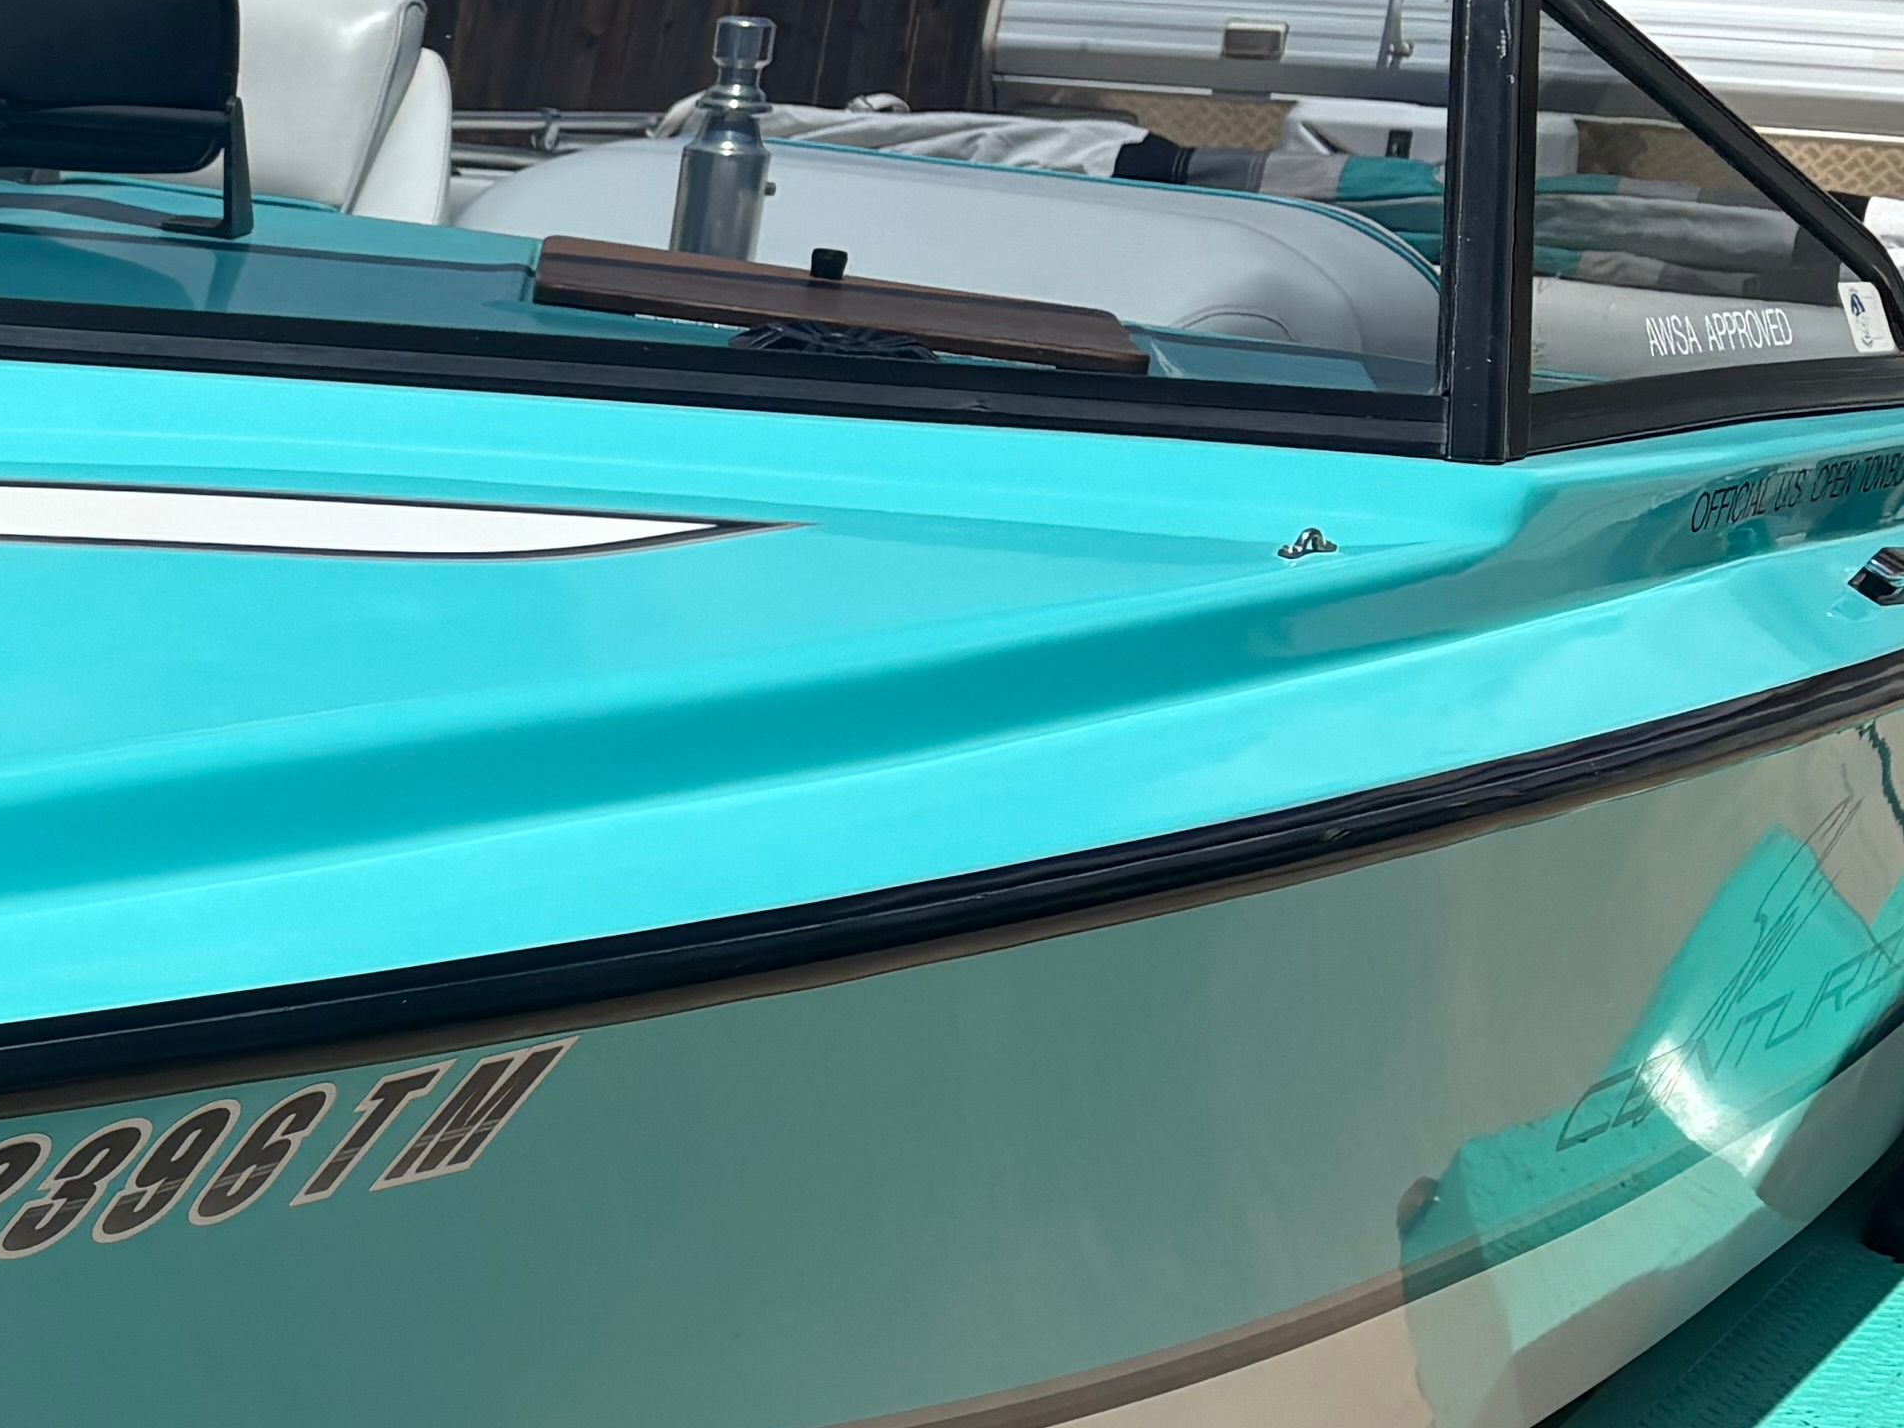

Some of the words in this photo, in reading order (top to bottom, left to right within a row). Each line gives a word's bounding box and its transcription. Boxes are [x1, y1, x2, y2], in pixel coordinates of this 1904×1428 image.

[1645, 314, 1702, 356] AWSA
[1705, 308, 1792, 350] APPROVED
[1691, 474, 1771, 533] OFFICIAL
[1811, 459, 1860, 501] OPEN
